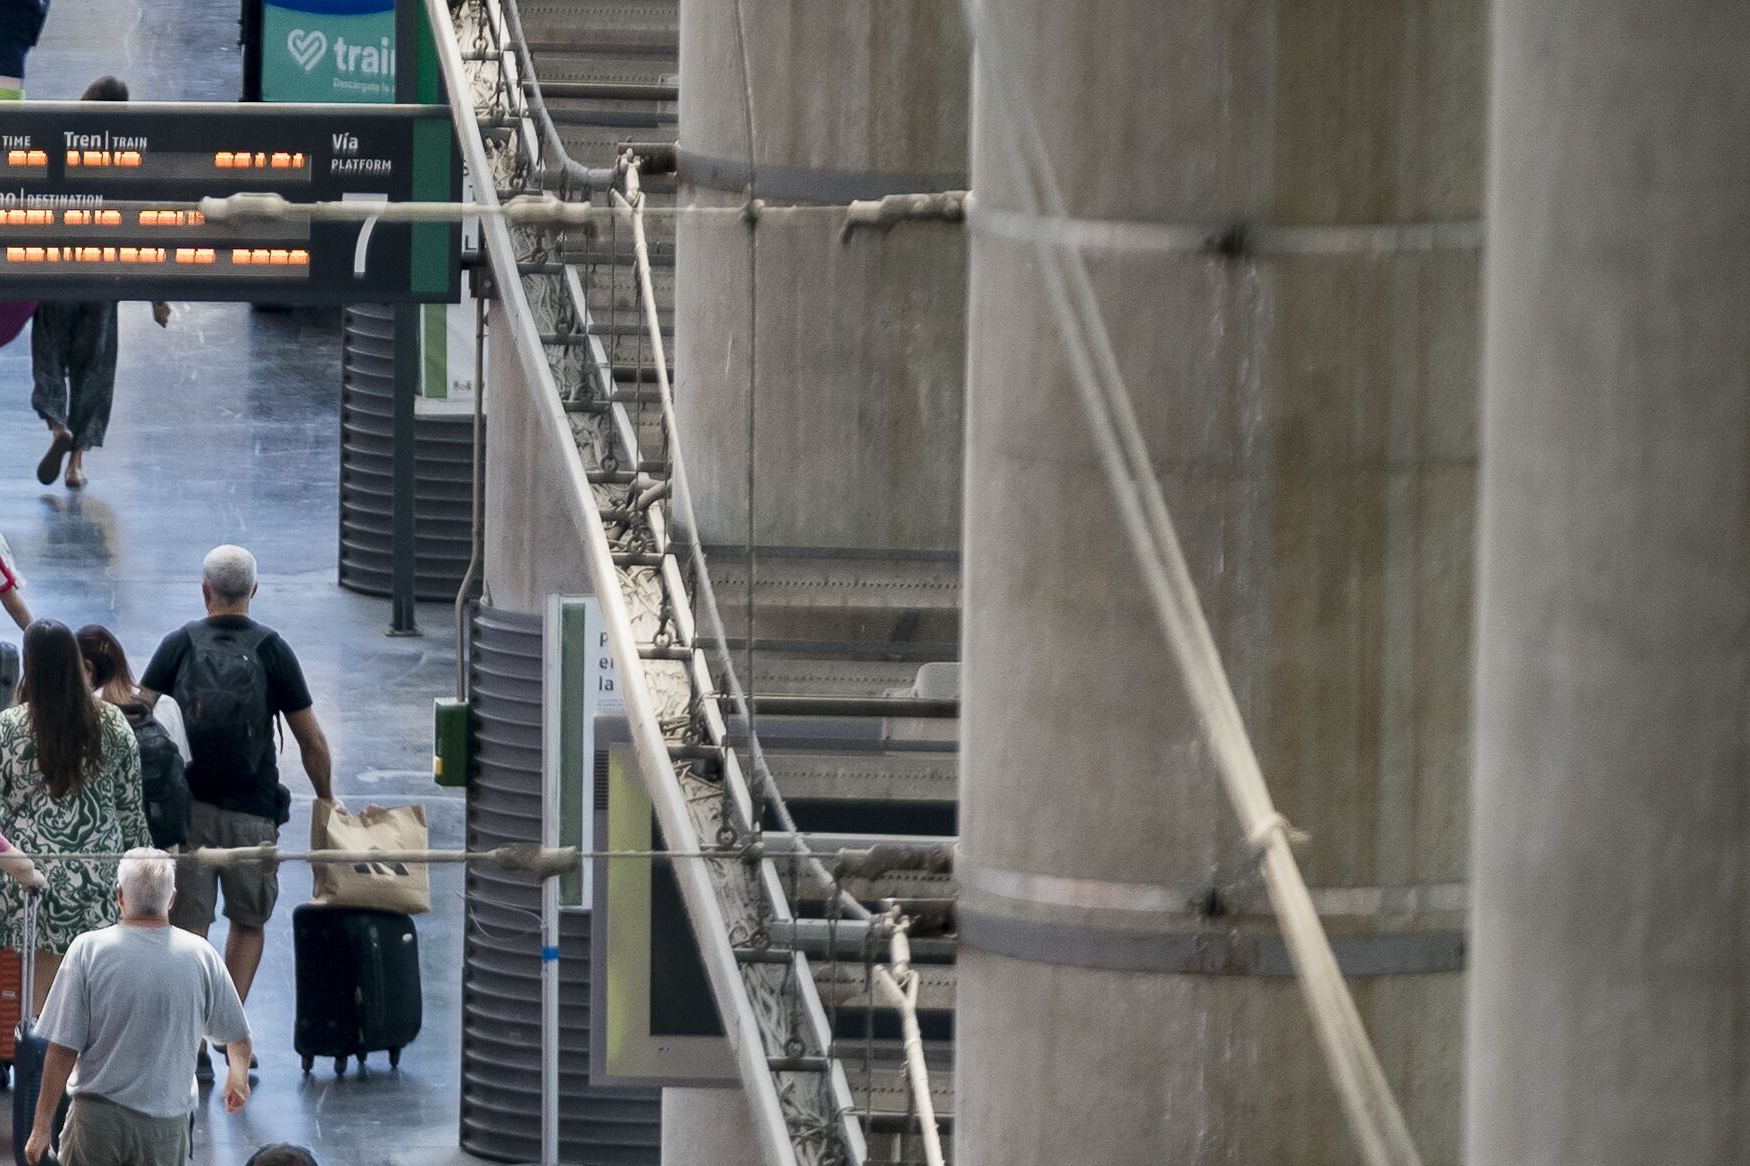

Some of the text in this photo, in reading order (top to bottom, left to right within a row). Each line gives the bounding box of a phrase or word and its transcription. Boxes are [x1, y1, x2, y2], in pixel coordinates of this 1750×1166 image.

[2, 135, 31, 147] TIME
[64, 131, 148, 149] Tren TRAIN
[332, 132, 359, 150] Vía
[331, 158, 392, 173] PLATFORM
[27, 194, 103, 208] DESTINATION
[342, 193, 388, 273] 7
